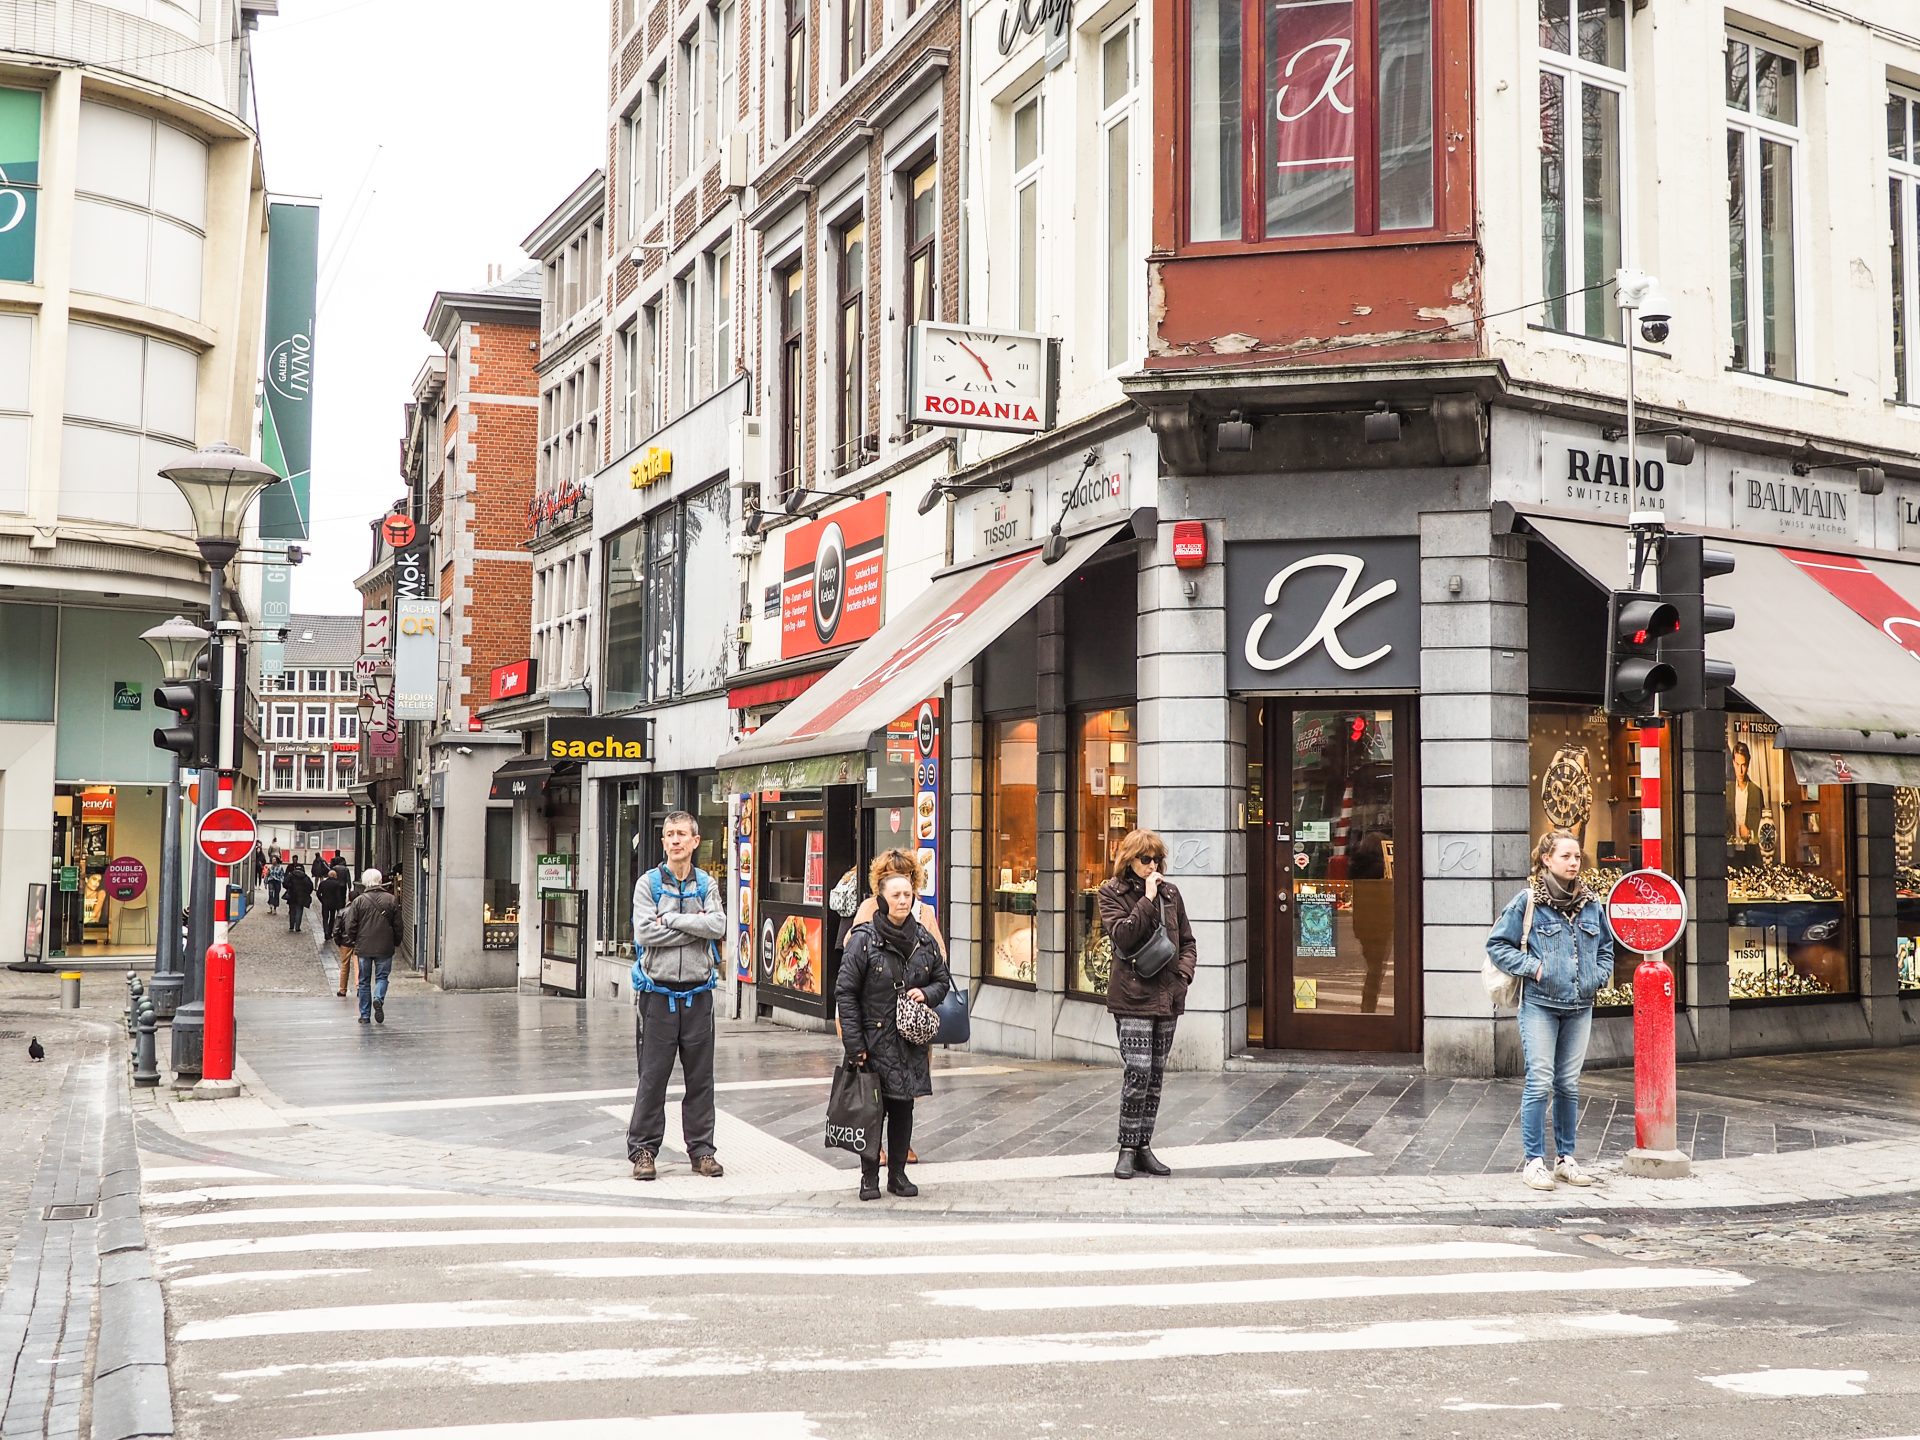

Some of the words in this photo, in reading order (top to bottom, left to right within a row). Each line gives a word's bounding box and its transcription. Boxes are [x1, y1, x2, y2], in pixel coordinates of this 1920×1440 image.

[279, 352, 288, 382] GALERIA
[291, 333, 311, 394] INNO
[924, 396, 1040, 422] RODANIA
[1567, 448, 1665, 492] RADO
[1567, 485, 1665, 509] SWITZERAND
[1747, 479, 1847, 521] BALMAIN
[984, 520, 1018, 546] TISSOT
[1779, 518, 1804, 529] swiss
[1810, 522, 1847, 535] watches
[397, 553, 420, 600] Wok
[821, 566, 836, 582] Happy
[820, 587, 836, 603] Kebab
[401, 605, 435, 613] ACHAT
[1244, 553, 1397, 671] K
[401, 617, 435, 635] OR
[356, 660, 376, 673] MA
[117, 696, 140, 704] INNO
[398, 693, 434, 701] BIJOUX
[398, 701, 434, 709] ATELIER
[1750, 722, 1779, 733] TISSOT
[551, 736, 642, 758] sacha
[542, 856, 561, 865] CAFÉ
[1734, 950, 1764, 959] TISSOT
[1663, 982, 1671, 996] 5
